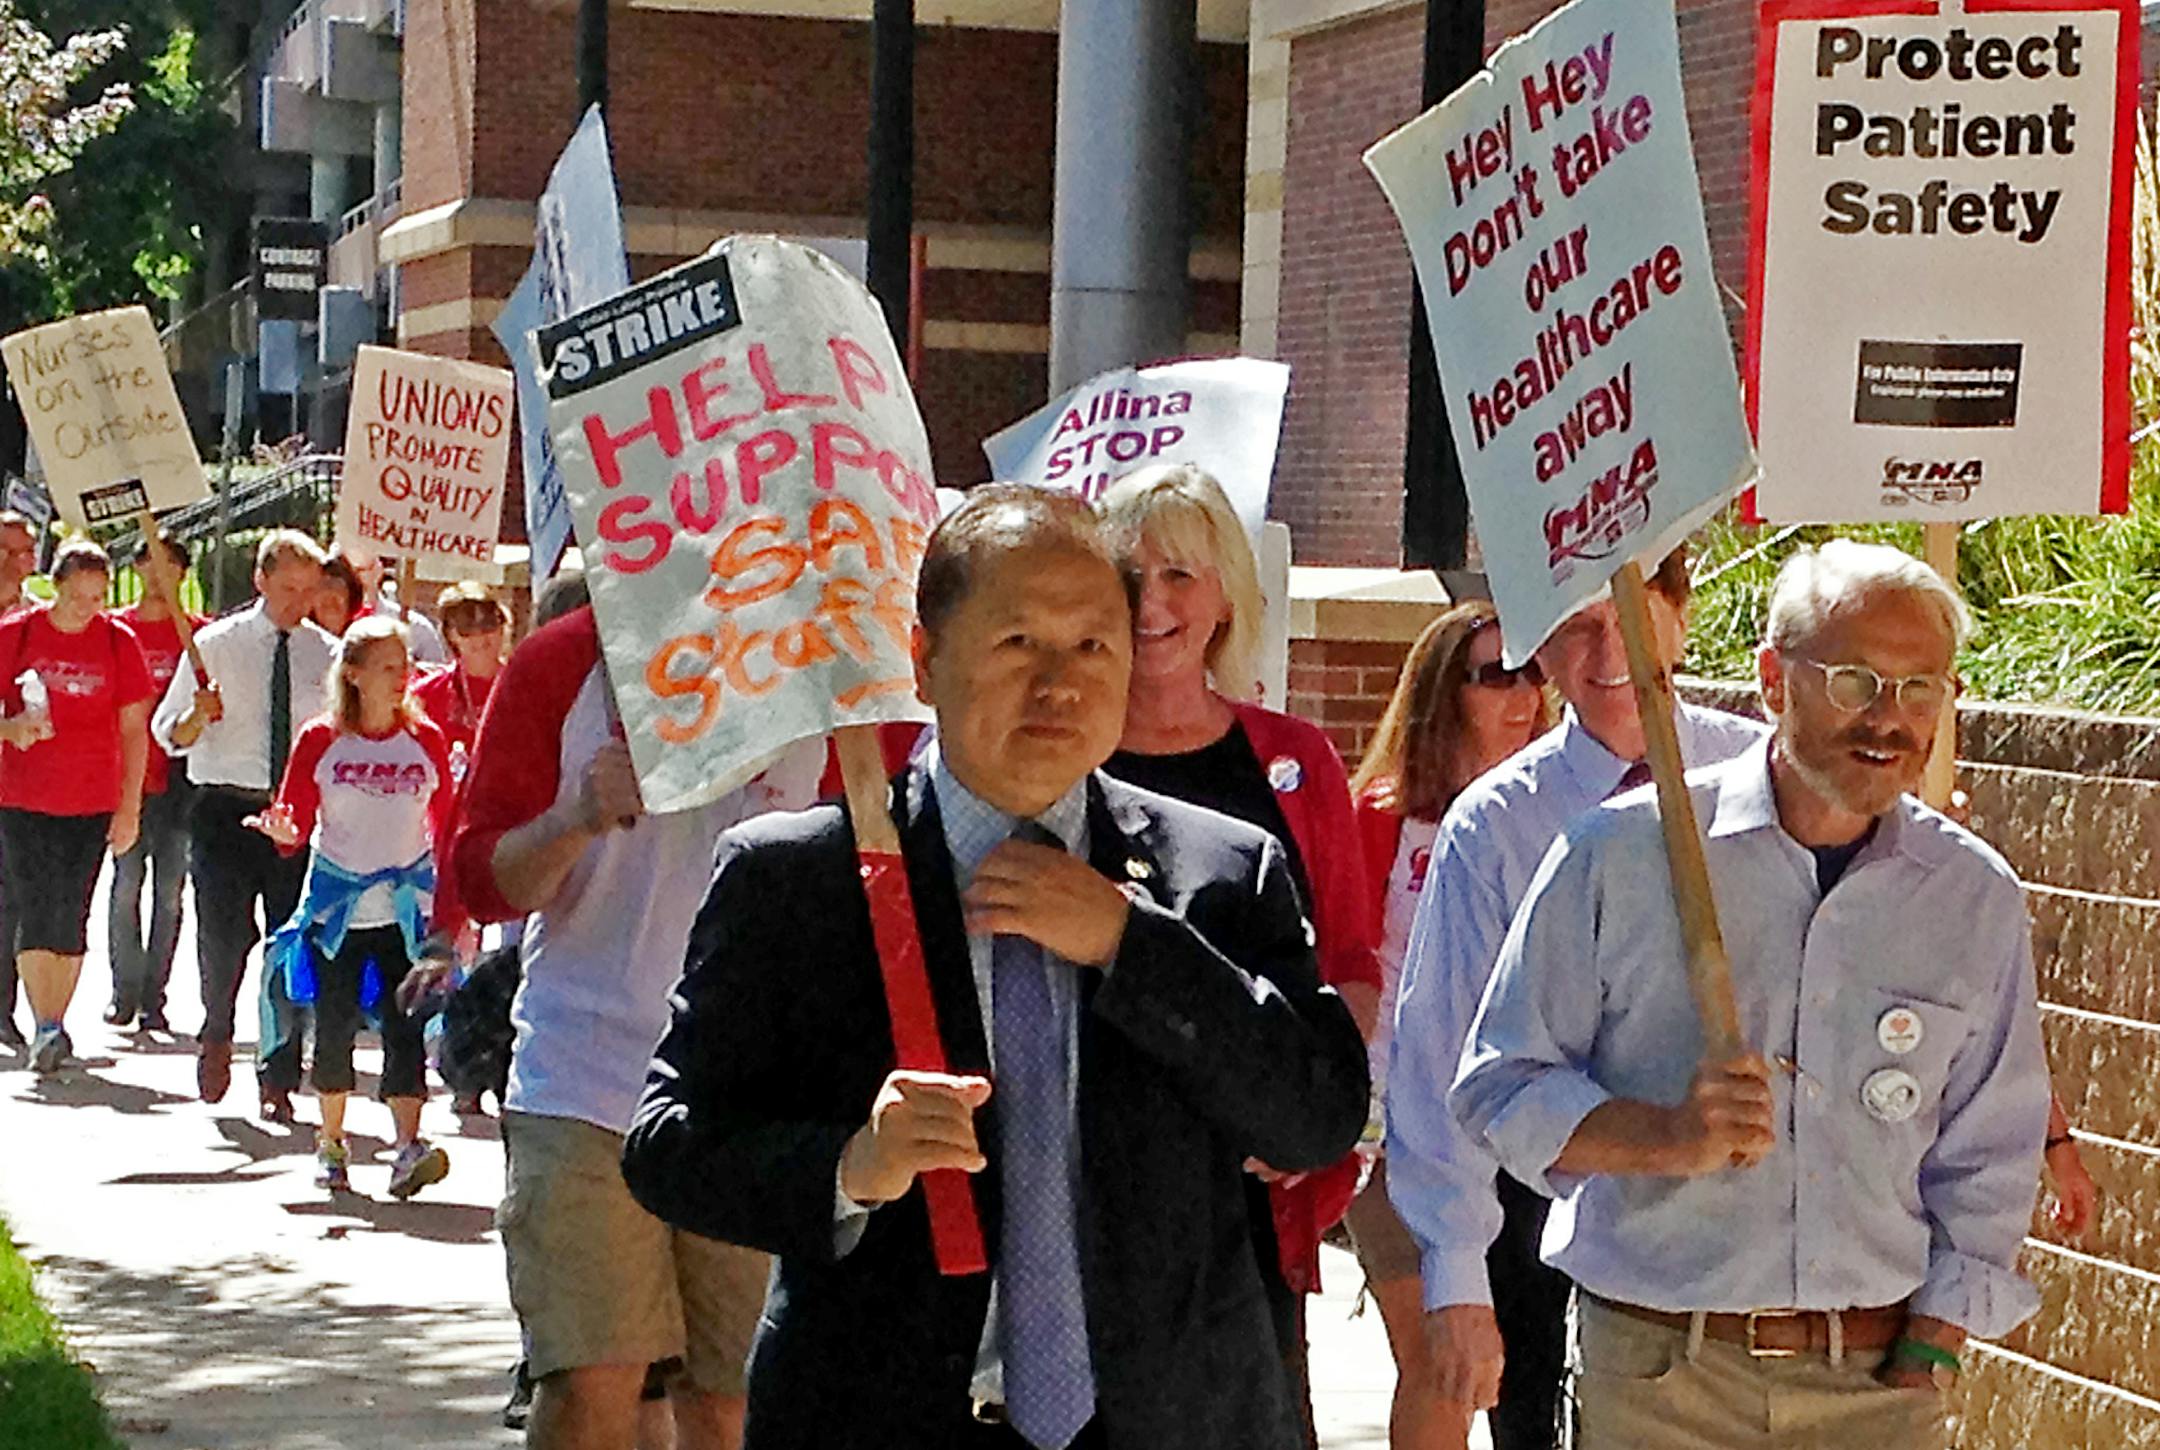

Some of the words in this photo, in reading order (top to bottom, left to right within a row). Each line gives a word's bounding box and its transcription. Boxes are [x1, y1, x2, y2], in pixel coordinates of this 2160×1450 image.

[1815, 24, 2083, 81] Protect
[1444, 104, 1514, 208] Hey
[1521, 31, 1615, 133] Hey
[1815, 102, 2077, 158] Patient
[1443, 164, 1545, 298] Don't
[1551, 94, 1653, 199] take
[1821, 179, 2061, 244] Safety
[1524, 223, 1590, 313] our
[20, 323, 133, 387] Nurses
[556, 279, 726, 382] STRIKE
[1468, 244, 1683, 452] healthcare
[35, 377, 83, 412] on
[94, 359, 154, 391] the
[378, 368, 505, 438] UNIONS
[582, 336, 887, 489] HELP
[1050, 388, 1193, 447] Allina
[54, 404, 180, 460] Outside
[364, 422, 483, 474] PROMOTE
[1044, 425, 1185, 480] STOP
[1533, 361, 1634, 483] away
[1885, 460, 1982, 480] MNA
[356, 500, 492, 563] HEALTHCARE
